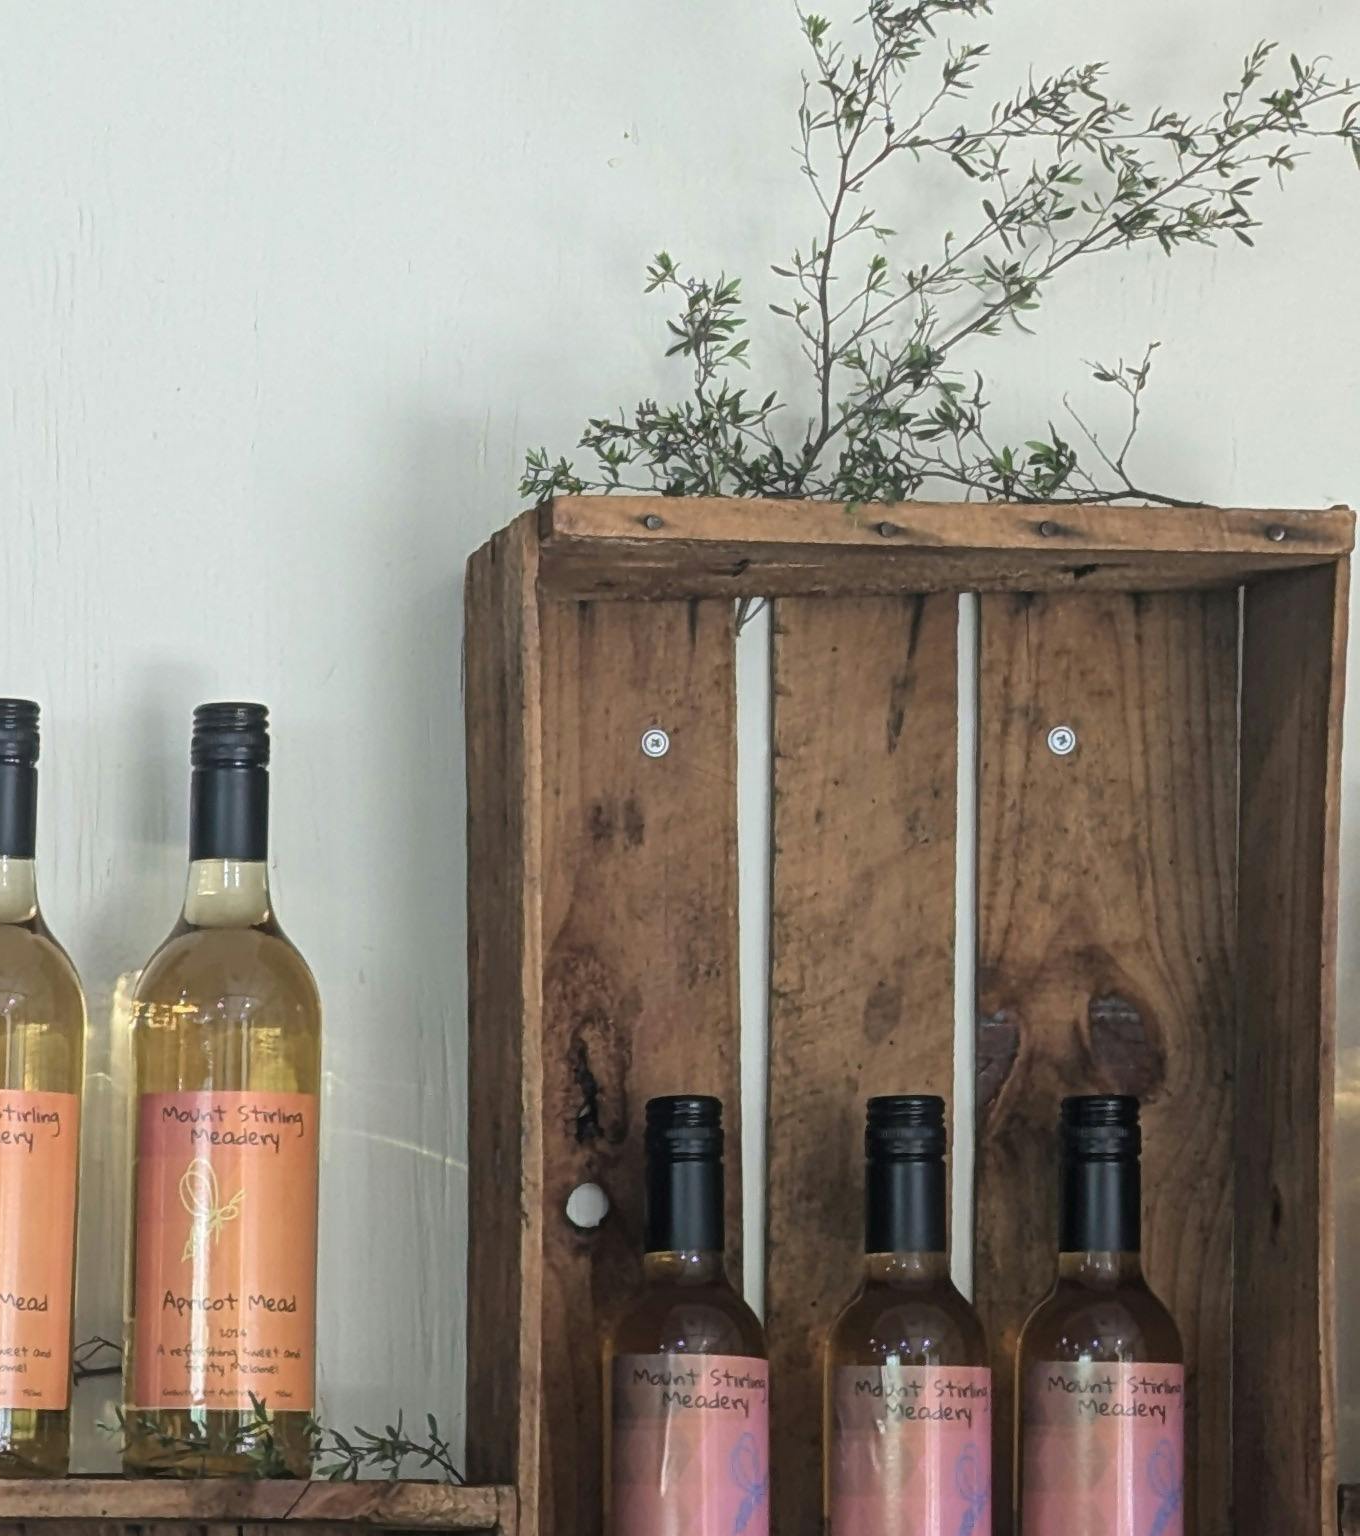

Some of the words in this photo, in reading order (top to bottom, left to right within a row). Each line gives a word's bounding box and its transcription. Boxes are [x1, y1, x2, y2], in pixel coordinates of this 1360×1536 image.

[162, 1106, 227, 1123] Mount
[238, 1105, 303, 1137] Stirling
[190, 1128, 279, 1153] Meadery
[163, 1290, 237, 1316] Apricot
[249, 1293, 296, 1312] Mead
[633, 1368, 699, 1387] Mount
[710, 1368, 767, 1403] Stirling
[855, 1381, 922, 1398] Mount
[1048, 1375, 1116, 1394] Mount
[662, 1391, 749, 1417] Meadery
[885, 1403, 972, 1429] Meadery
[1079, 1399, 1166, 1425] Meadery
